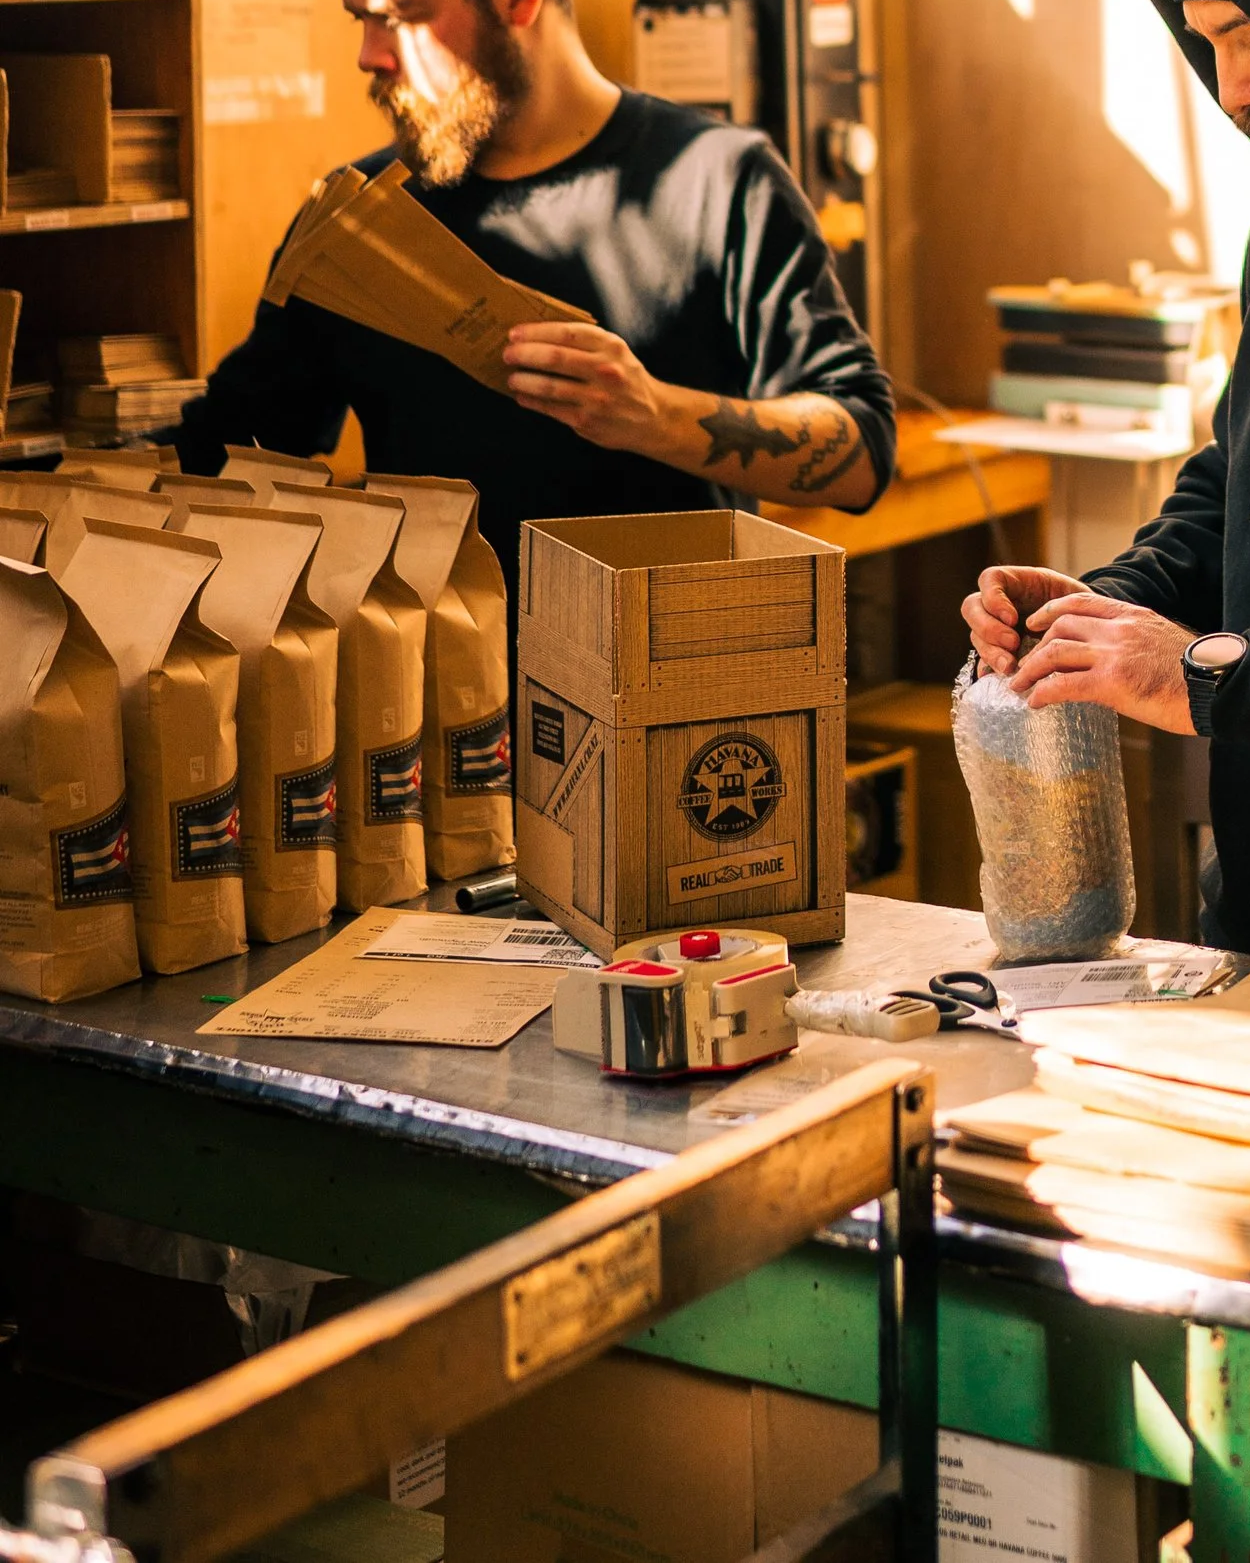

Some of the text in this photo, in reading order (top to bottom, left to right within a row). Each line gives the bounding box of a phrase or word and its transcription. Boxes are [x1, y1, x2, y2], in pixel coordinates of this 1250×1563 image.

[704, 745, 760, 771] HAVANA
[678, 785, 783, 807] COFFEE WORKS
[712, 822, 728, 832] EST
[680, 856, 785, 892] REAL TRADE
[938, 1454, 964, 1469] etpak
[999, 1540, 1025, 1554] HAVANA
